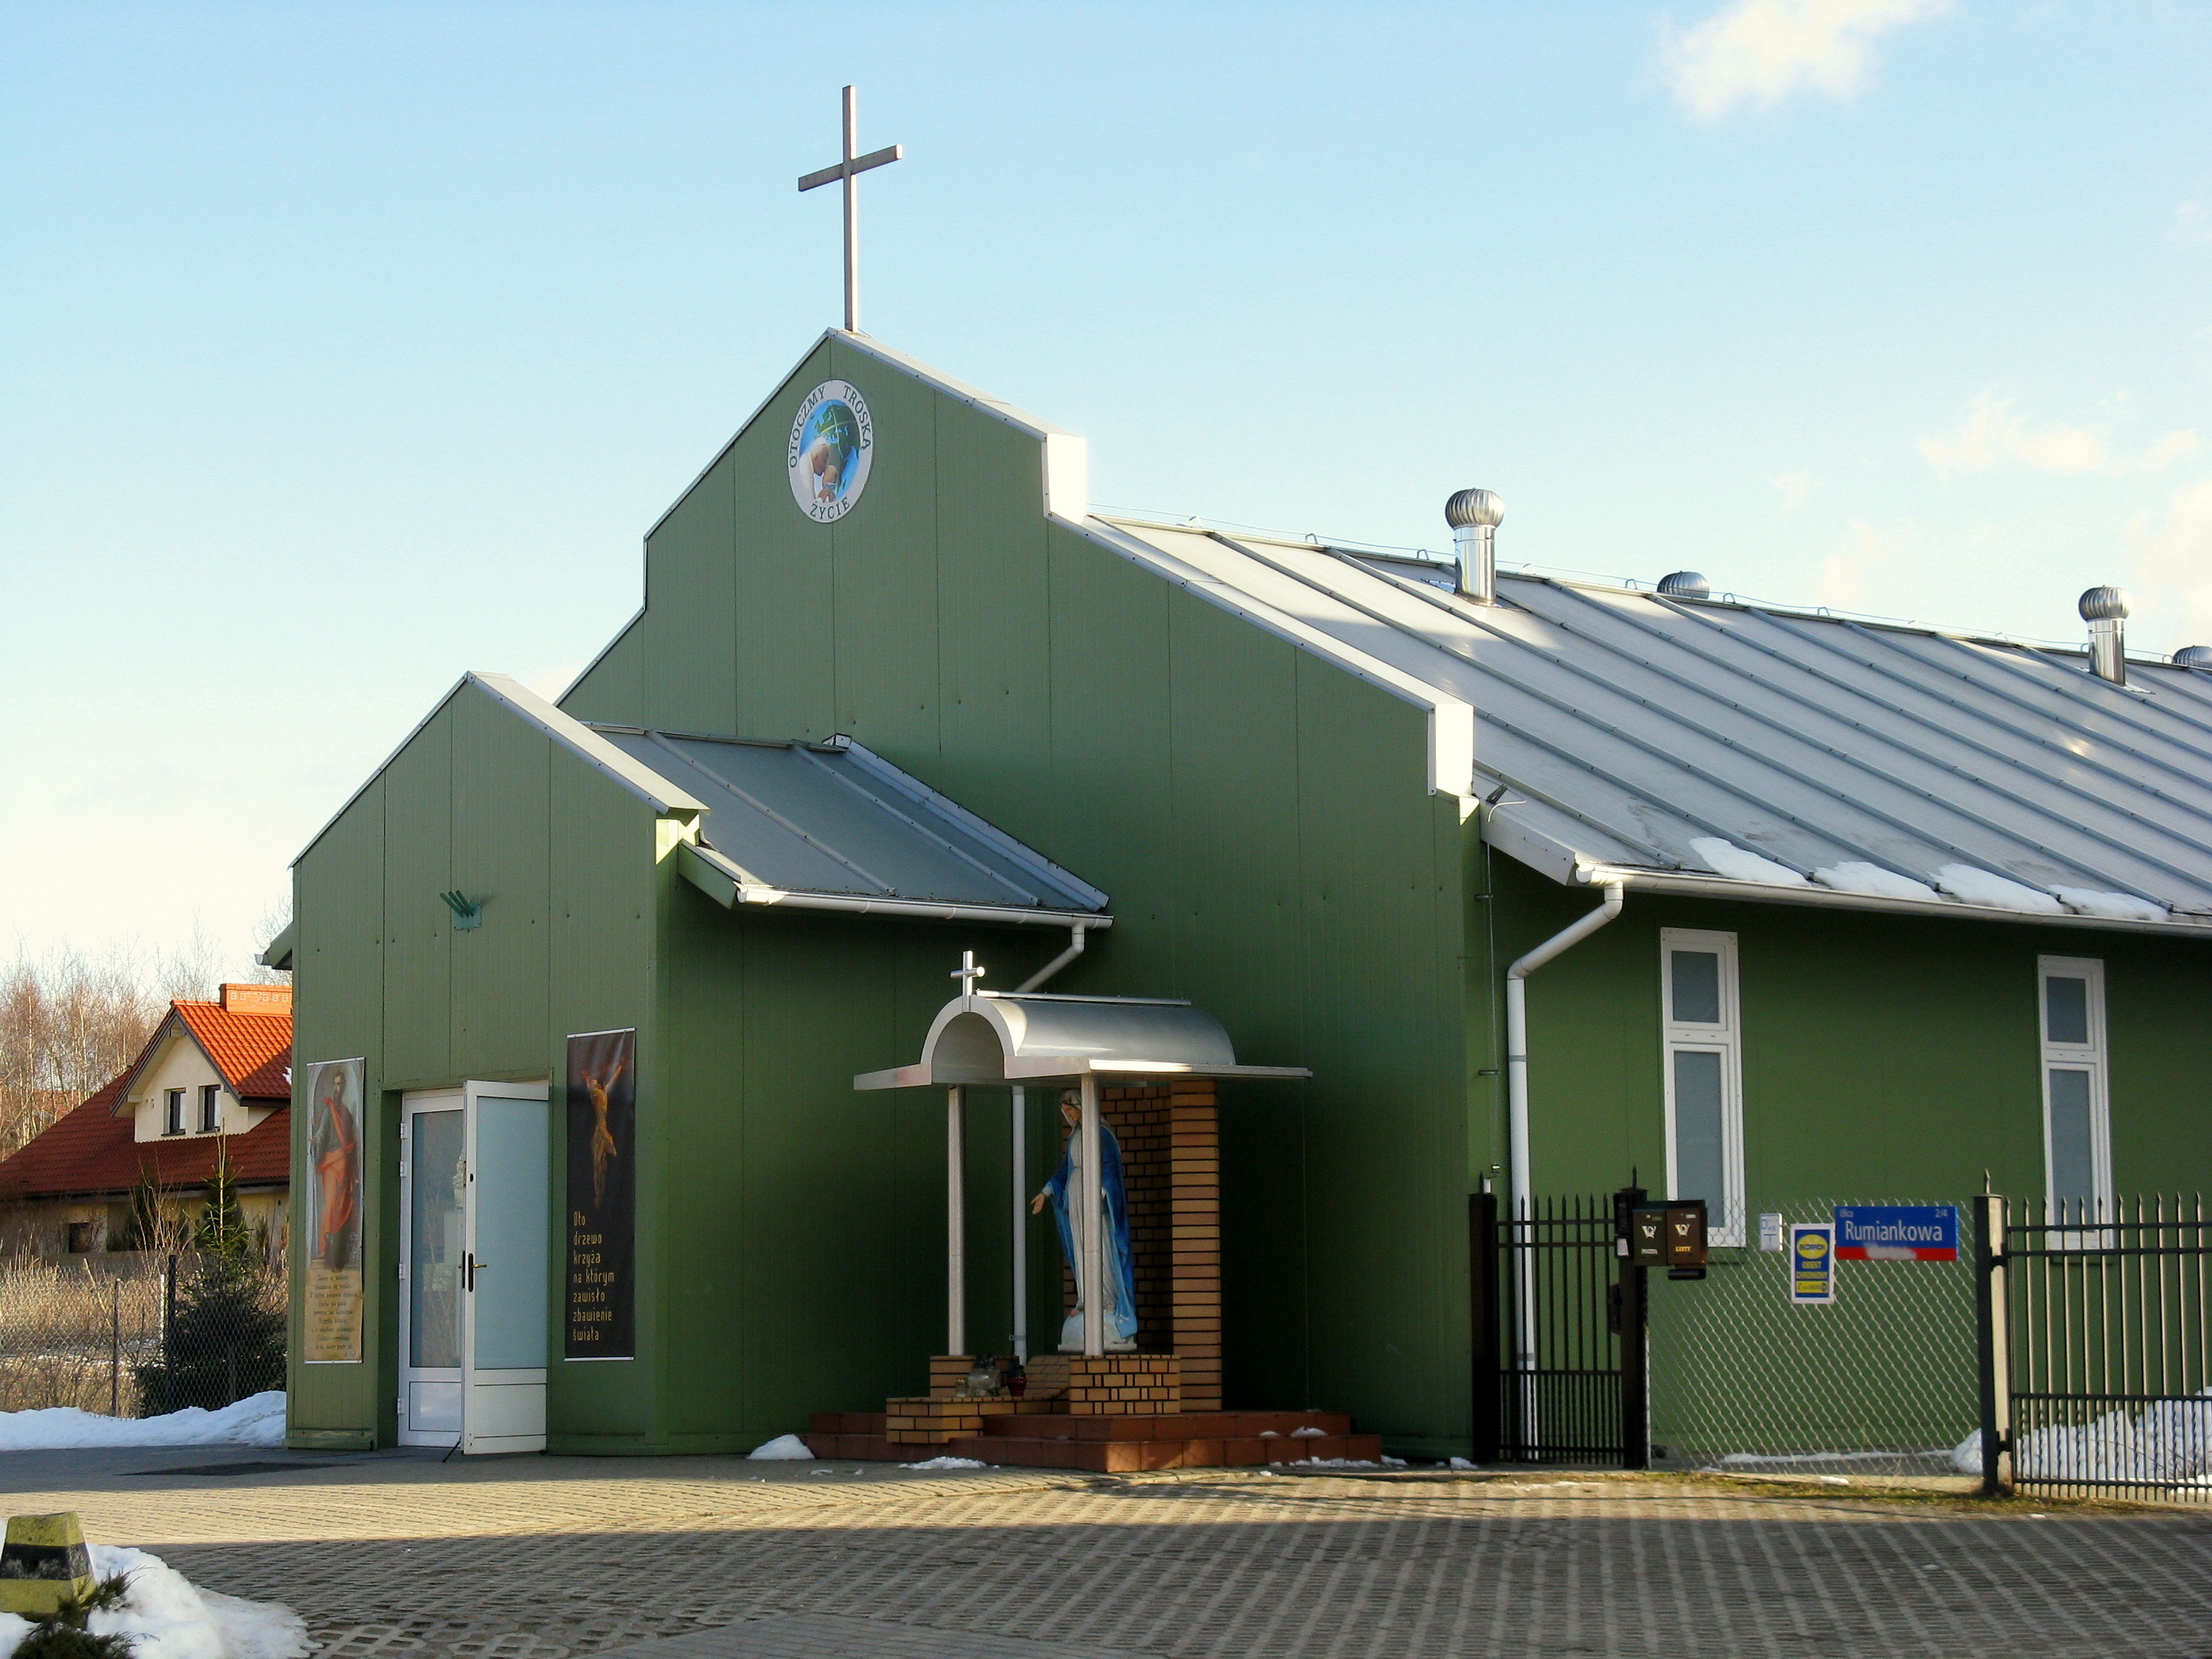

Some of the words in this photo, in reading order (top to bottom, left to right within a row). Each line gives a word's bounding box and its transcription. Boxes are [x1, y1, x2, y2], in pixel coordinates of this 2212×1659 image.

[790, 385, 826, 468] OTOCZMY
[810, 497, 850, 520] ŻYCIE
[573, 1211, 586, 1226] Oto
[573, 1230, 602, 1246] drzewo
[1845, 1219, 1943, 1242] Rumiankowa
[573, 1250, 601, 1267] krzyża
[573, 1273, 582, 1284] na
[586, 1268, 615, 1286] którym
[573, 1287, 605, 1303] zawisło
[573, 1307, 613, 1322] zbawienie
[573, 1325, 600, 1341] świata
